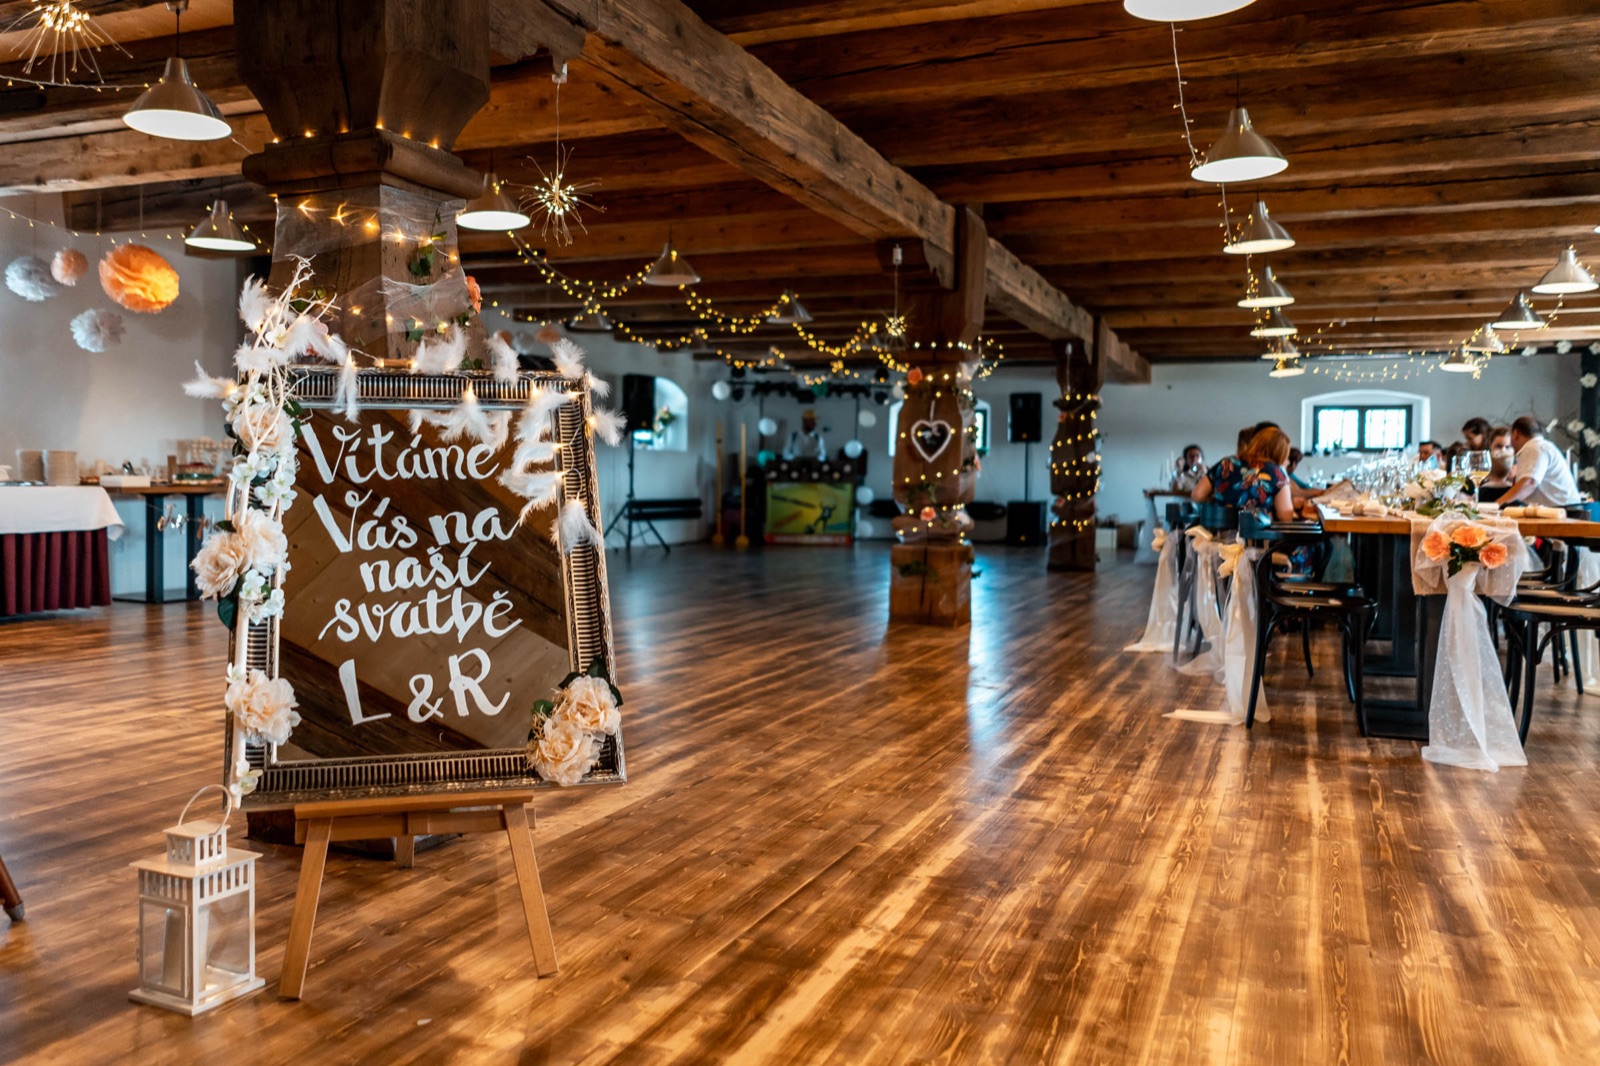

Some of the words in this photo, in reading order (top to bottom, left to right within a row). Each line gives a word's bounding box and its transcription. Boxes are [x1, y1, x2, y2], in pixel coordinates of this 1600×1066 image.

[300, 422, 500, 485] Vítáme
[312, 489, 419, 553] Vás
[428, 507, 520, 546] na
[318, 587, 523, 644] svatbě
[338, 658, 392, 726] L
[407, 673, 444, 723] &
[448, 647, 511, 717] R
